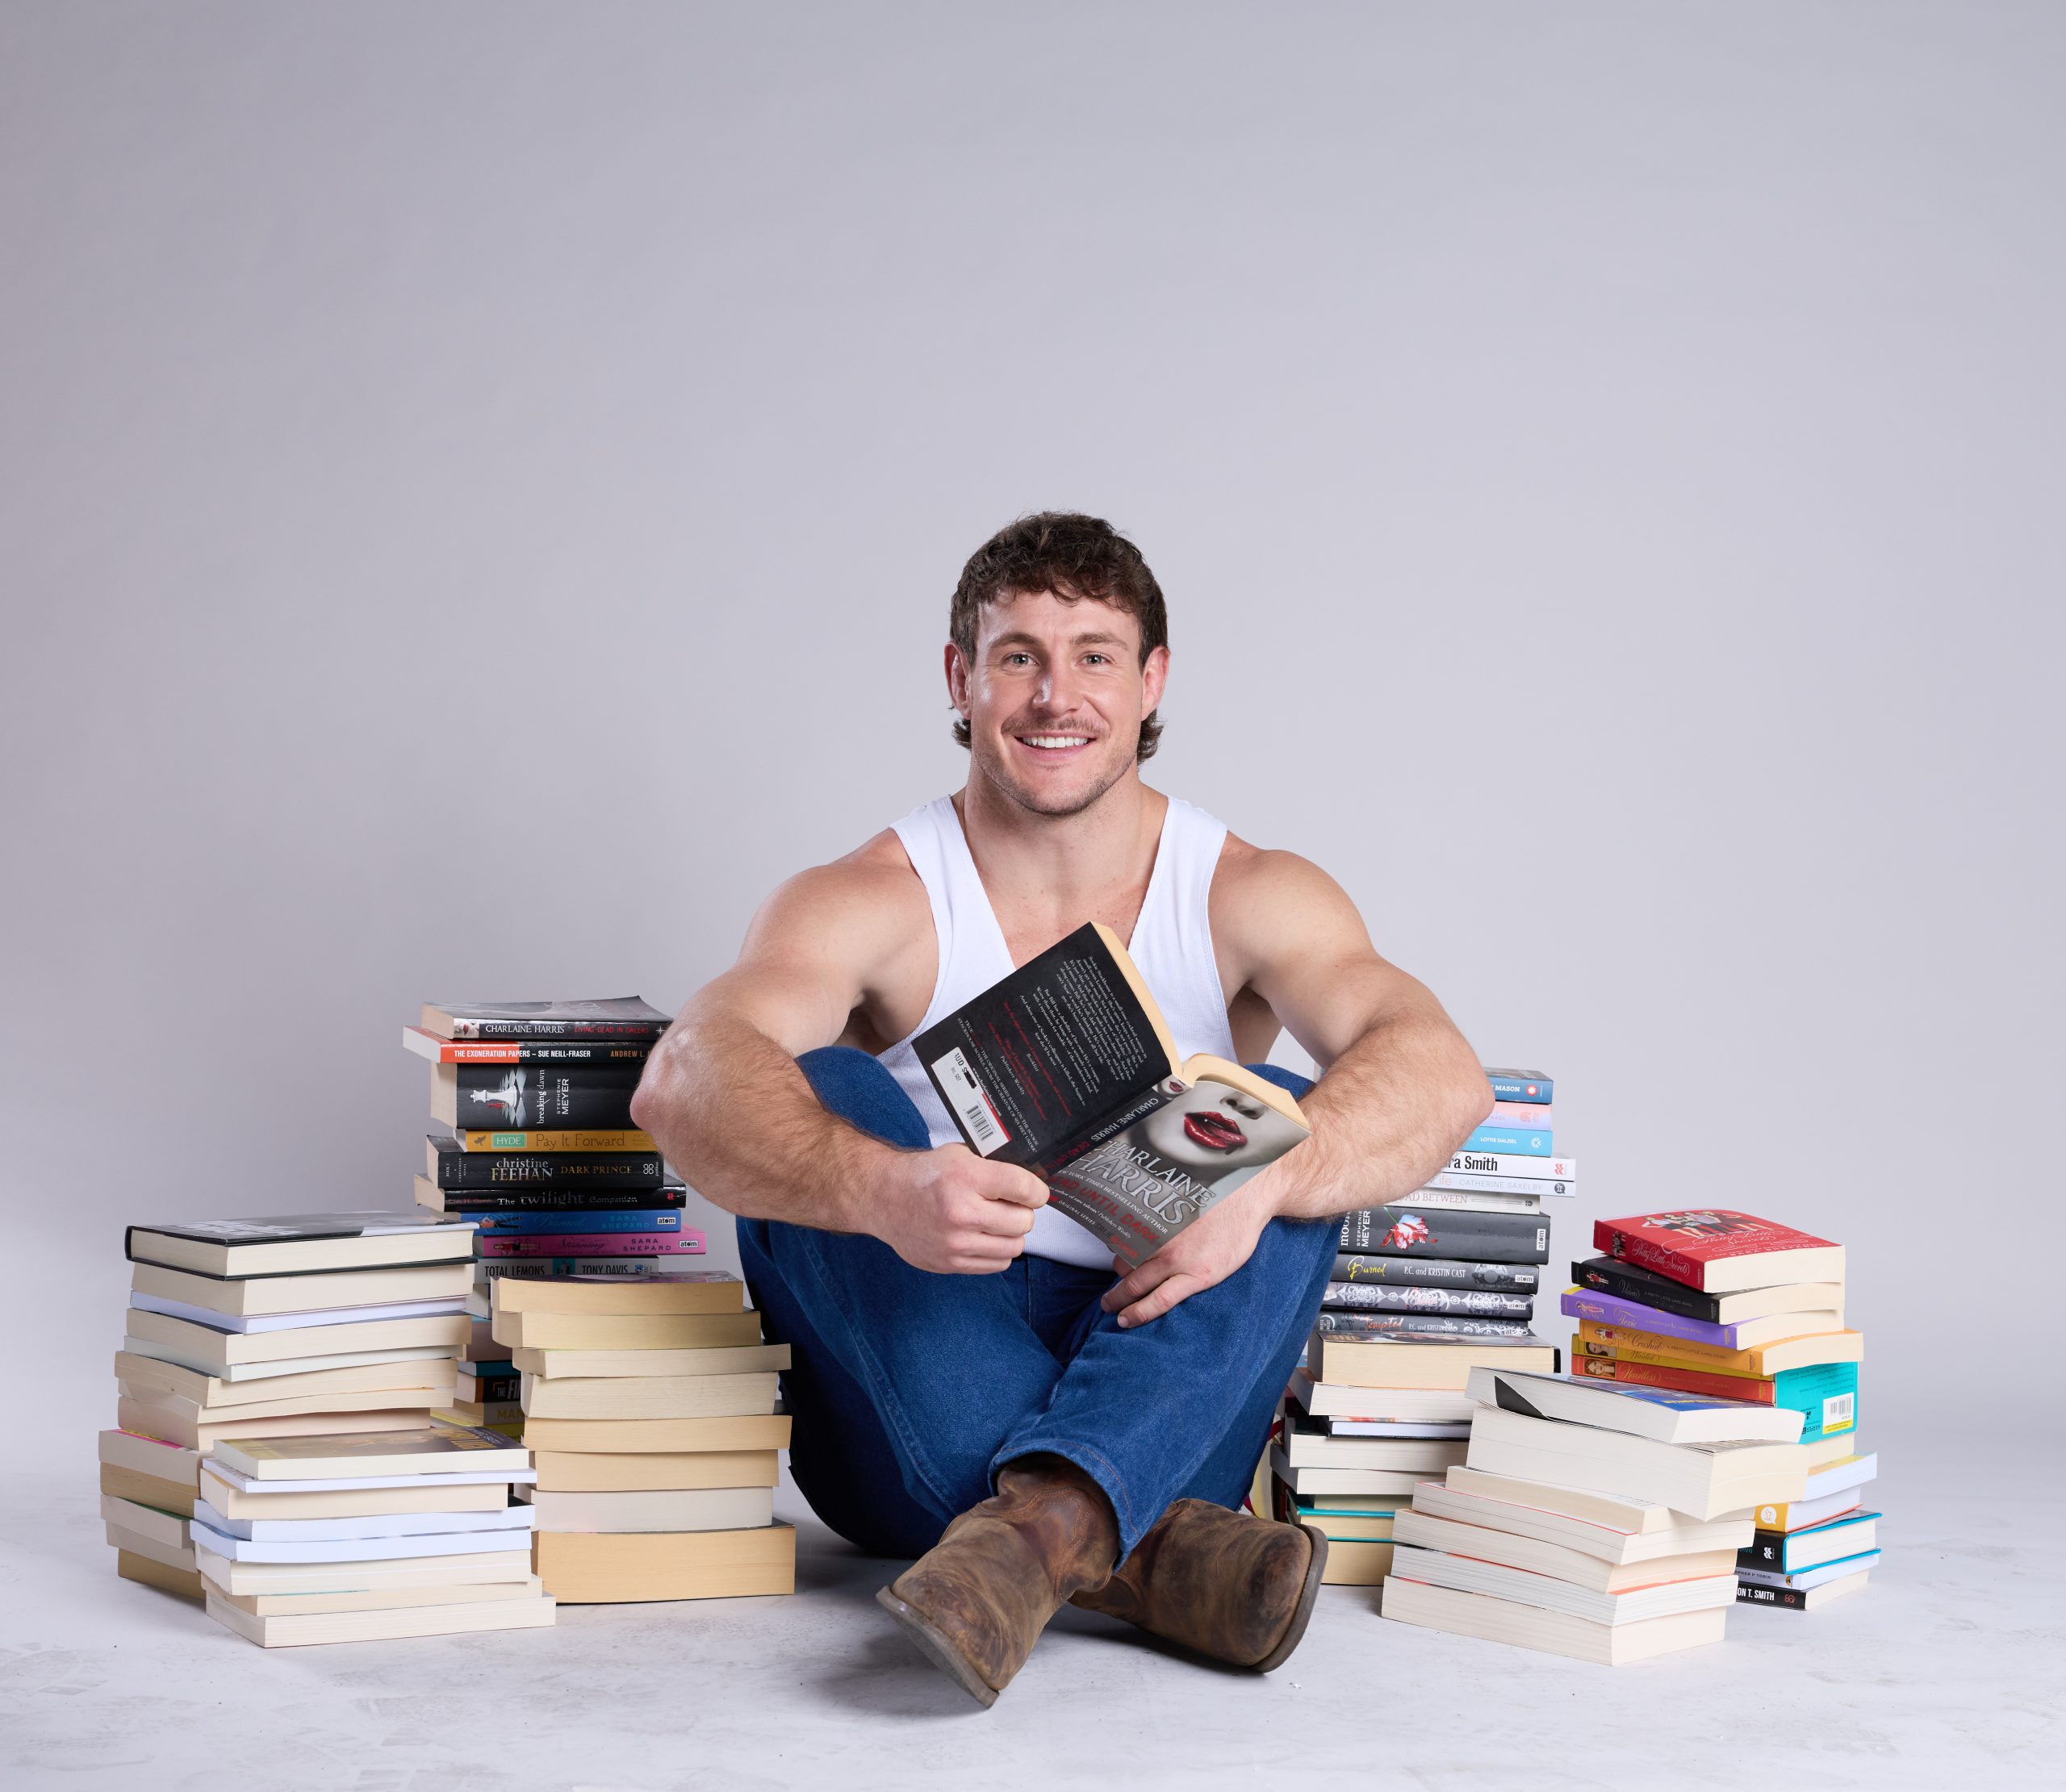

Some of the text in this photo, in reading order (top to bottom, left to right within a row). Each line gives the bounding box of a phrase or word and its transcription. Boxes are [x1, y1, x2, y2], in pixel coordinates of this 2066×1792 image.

[485, 1025, 533, 1033] CHARLAINE
[534, 1025, 565, 1034] HARRIS
[454, 1050, 466, 1058] THE
[466, 1050, 507, 1058] EXONERATION
[508, 1050, 530, 1058] PAPERS
[537, 1050, 550, 1058] SUE
[551, 1050, 591, 1058] NEILL-FRASER
[610, 1050, 638, 1058] ANDREW
[537, 1069, 548, 1124] breaking dawn
[1495, 1084, 1520, 1092] MASON
[1116, 1097, 1159, 1127] CHARLAINE
[496, 1136, 522, 1145] HYDE
[1090, 1122, 1119, 1142] HARRIS
[536, 1133, 557, 1150] Pay
[562, 1133, 570, 1147] It
[575, 1132, 626, 1147] Forward
[496, 1157, 549, 1168] christine
[1465, 1155, 1498, 1172] Smith
[491, 1165, 633, 1181] FEEHAN DARK PRINCE
[1094, 1140, 1216, 1208] HARLAINE
[1068, 1151, 1197, 1225] HARRIS
[1459, 1179, 1503, 1188] CATHERINE
[496, 1197, 516, 1205] The
[519, 1190, 585, 1208] twilight
[1085, 1178, 1105, 1190] TIMES
[1104, 1186, 1144, 1214] BESTSELLING
[1141, 1213, 1169, 1235] AUTHOR
[1423, 1193, 1468, 1204] BETWEEN
[1119, 1212, 1161, 1245] DARK
[1361, 1210, 1371, 1247] MEYER
[484, 1264, 628, 1276] TOTAL LEMONS TONY DAVIS
[1348, 1255, 1466, 1280] Burned P.C. and KRISTIN CAST
[1737, 1587, 1775, 1601] ON T. SMITH
